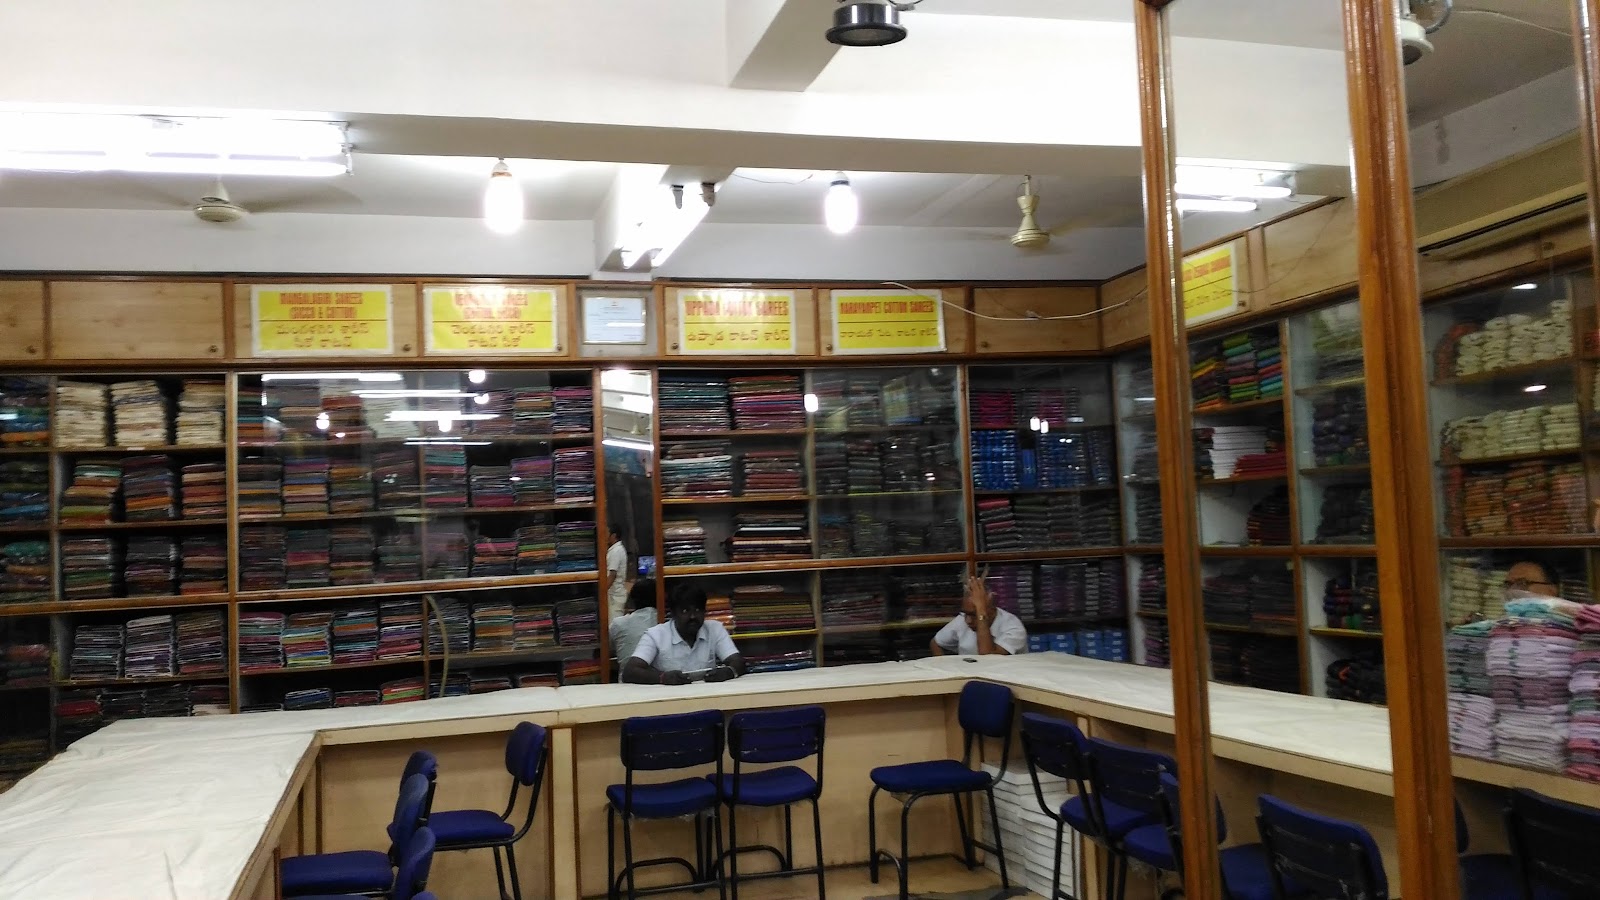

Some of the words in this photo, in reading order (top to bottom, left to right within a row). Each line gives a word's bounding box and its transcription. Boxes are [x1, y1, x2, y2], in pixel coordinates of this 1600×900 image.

[335, 292, 363, 305] SAREES
[685, 301, 720, 316] UPPADA
[755, 301, 789, 316] SAREES
[884, 301, 907, 314] COTTON
[910, 301, 935, 313] SAREES
